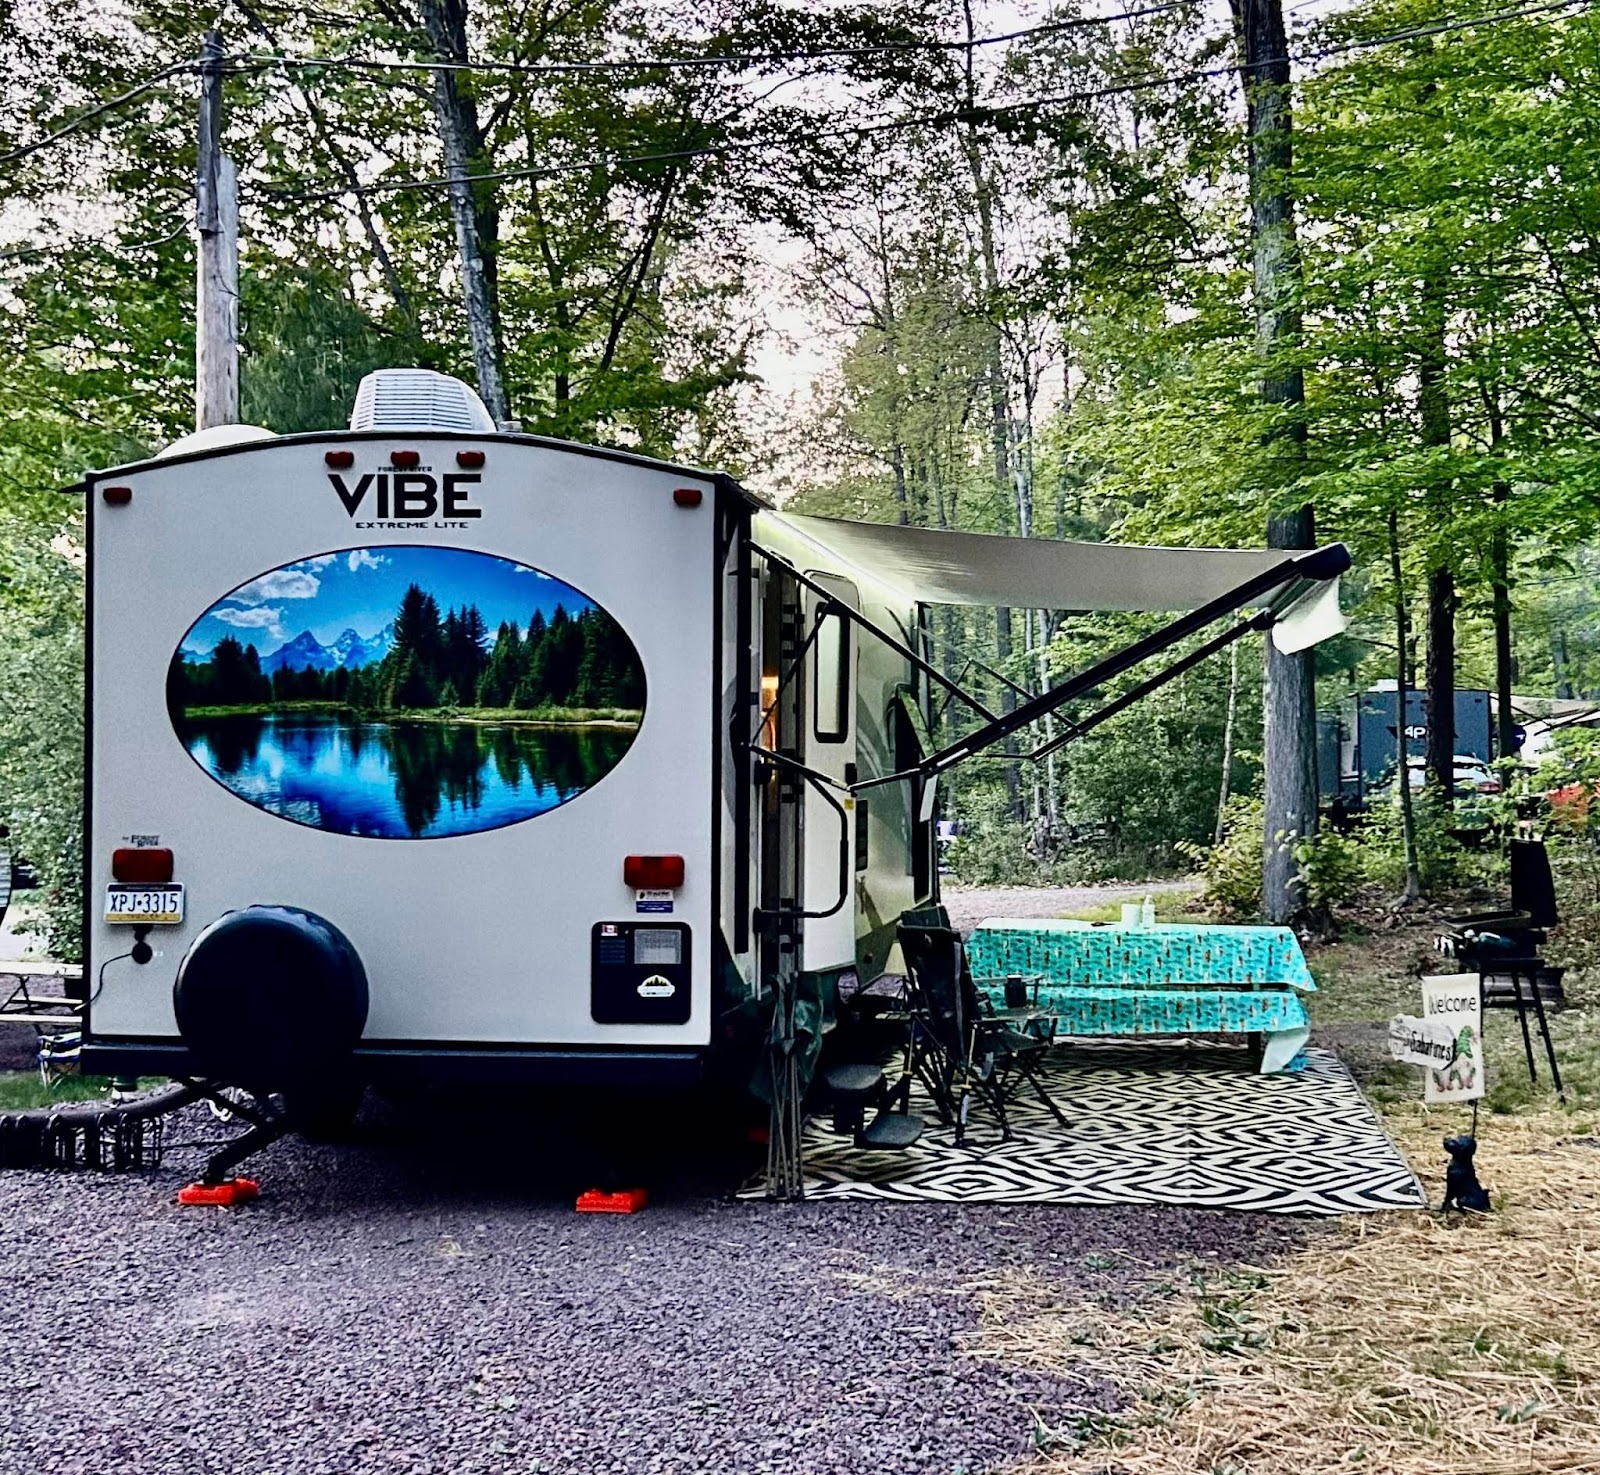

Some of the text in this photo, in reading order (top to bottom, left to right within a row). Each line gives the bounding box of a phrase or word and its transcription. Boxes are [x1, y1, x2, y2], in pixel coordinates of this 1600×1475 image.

[327, 473, 482, 519] VIBE
[355, 521, 469, 529] EXTREME LITE
[1428, 993, 1477, 1015] Welcome
